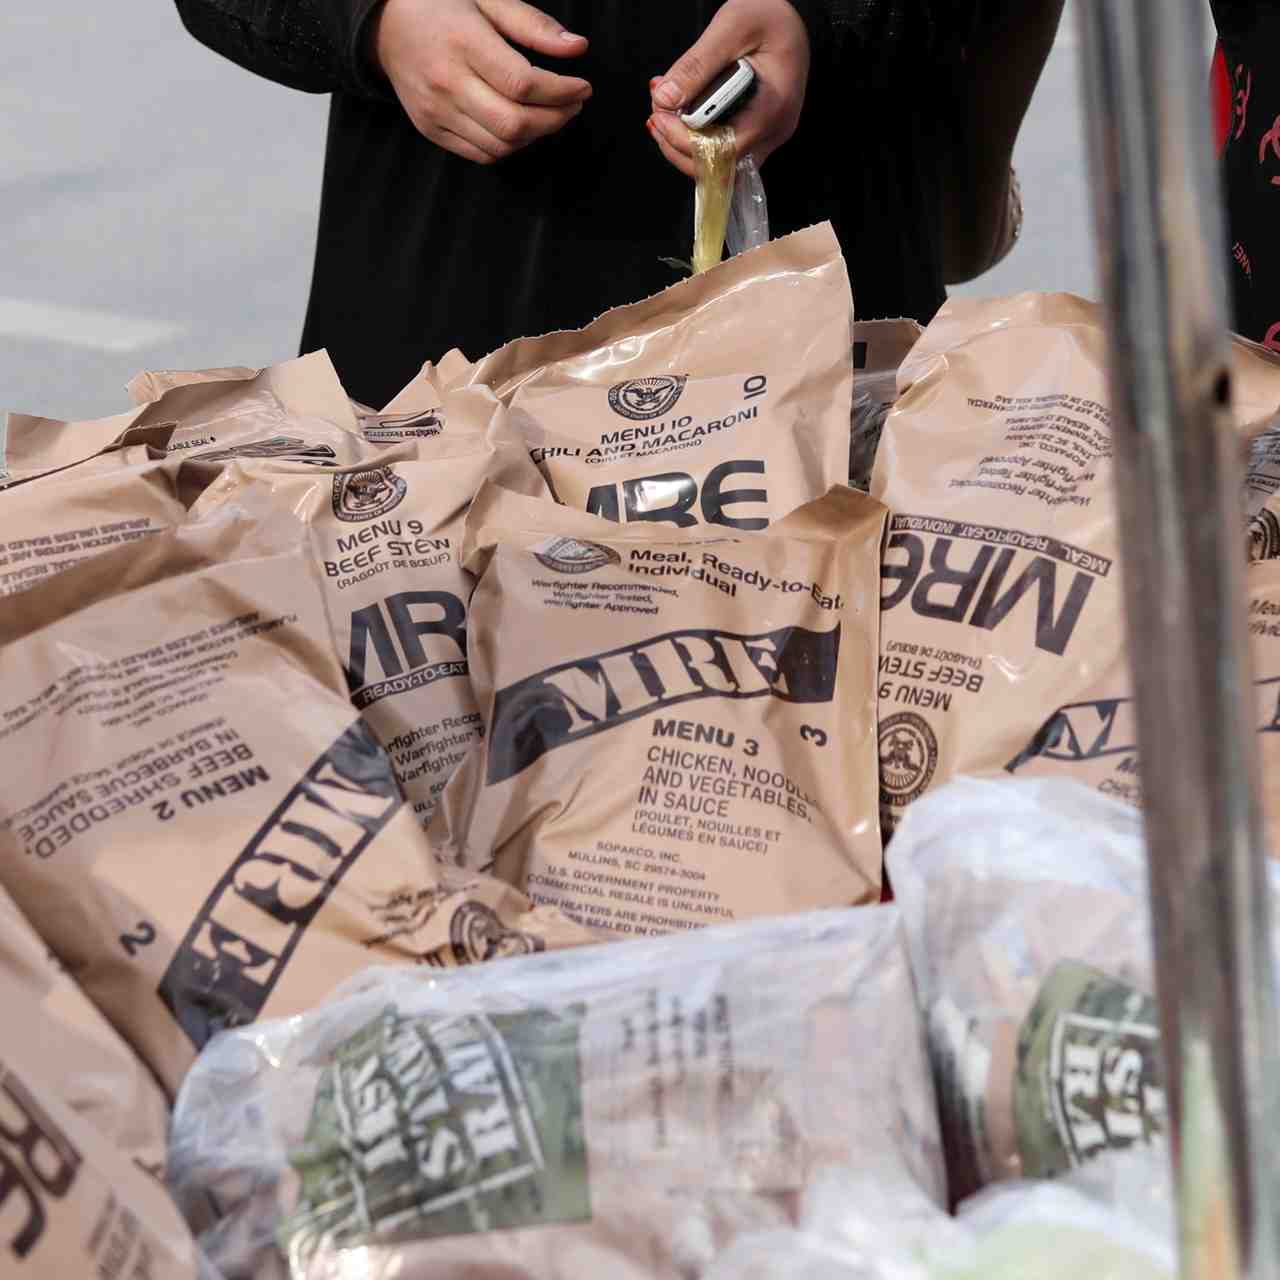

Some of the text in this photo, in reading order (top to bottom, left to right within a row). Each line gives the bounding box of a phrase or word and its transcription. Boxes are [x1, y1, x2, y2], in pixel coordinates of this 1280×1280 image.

[529, 406, 759, 465] CHILI AND MACARONI
[600, 415, 693, 445] MENU 10
[336, 519, 424, 554] MENU 9
[324, 537, 451, 578] BEEF STEW
[393, 556, 409, 568] DE
[531, 578, 589, 592] Warfighter
[628, 563, 738, 598] Individual
[604, 603, 660, 616] Approved
[363, 661, 466, 703] READY-TO-EAT
[544, 635, 791, 736] MRE
[926, 662, 985, 693] BEEF
[878, 682, 952, 712] MENU 9
[214, 727, 240, 744] IN
[652, 719, 760, 758] MENU 3
[799, 723, 828, 747] 3
[94, 737, 212, 798] BARBECUE
[185, 742, 253, 781] BEEF
[646, 745, 738, 778] CHICKEN,
[151, 764, 271, 822] MENU 2
[638, 786, 730, 819] IN SAUCE
[642, 765, 813, 825] AND VEGETABLES,
[17, 789, 92, 842] SAUCE
[697, 818, 764, 839] NOUILLES
[767, 830, 782, 843] ET
[698, 831, 716, 845] EN
[719, 835, 770, 856] SAUCE)
[194, 761, 395, 986] MRE
[624, 859, 642, 872] SC
[526, 872, 606, 898] COMMERCIAL
[608, 888, 656, 907] RESALE
[657, 896, 670, 909] IS
[572, 869, 655, 893] GOVERNMENT
[658, 883, 722, 902] PROPERTY
[560, 898, 613, 919] HEATERS
[614, 908, 639, 922] ARE
[119, 920, 156, 957] 2
